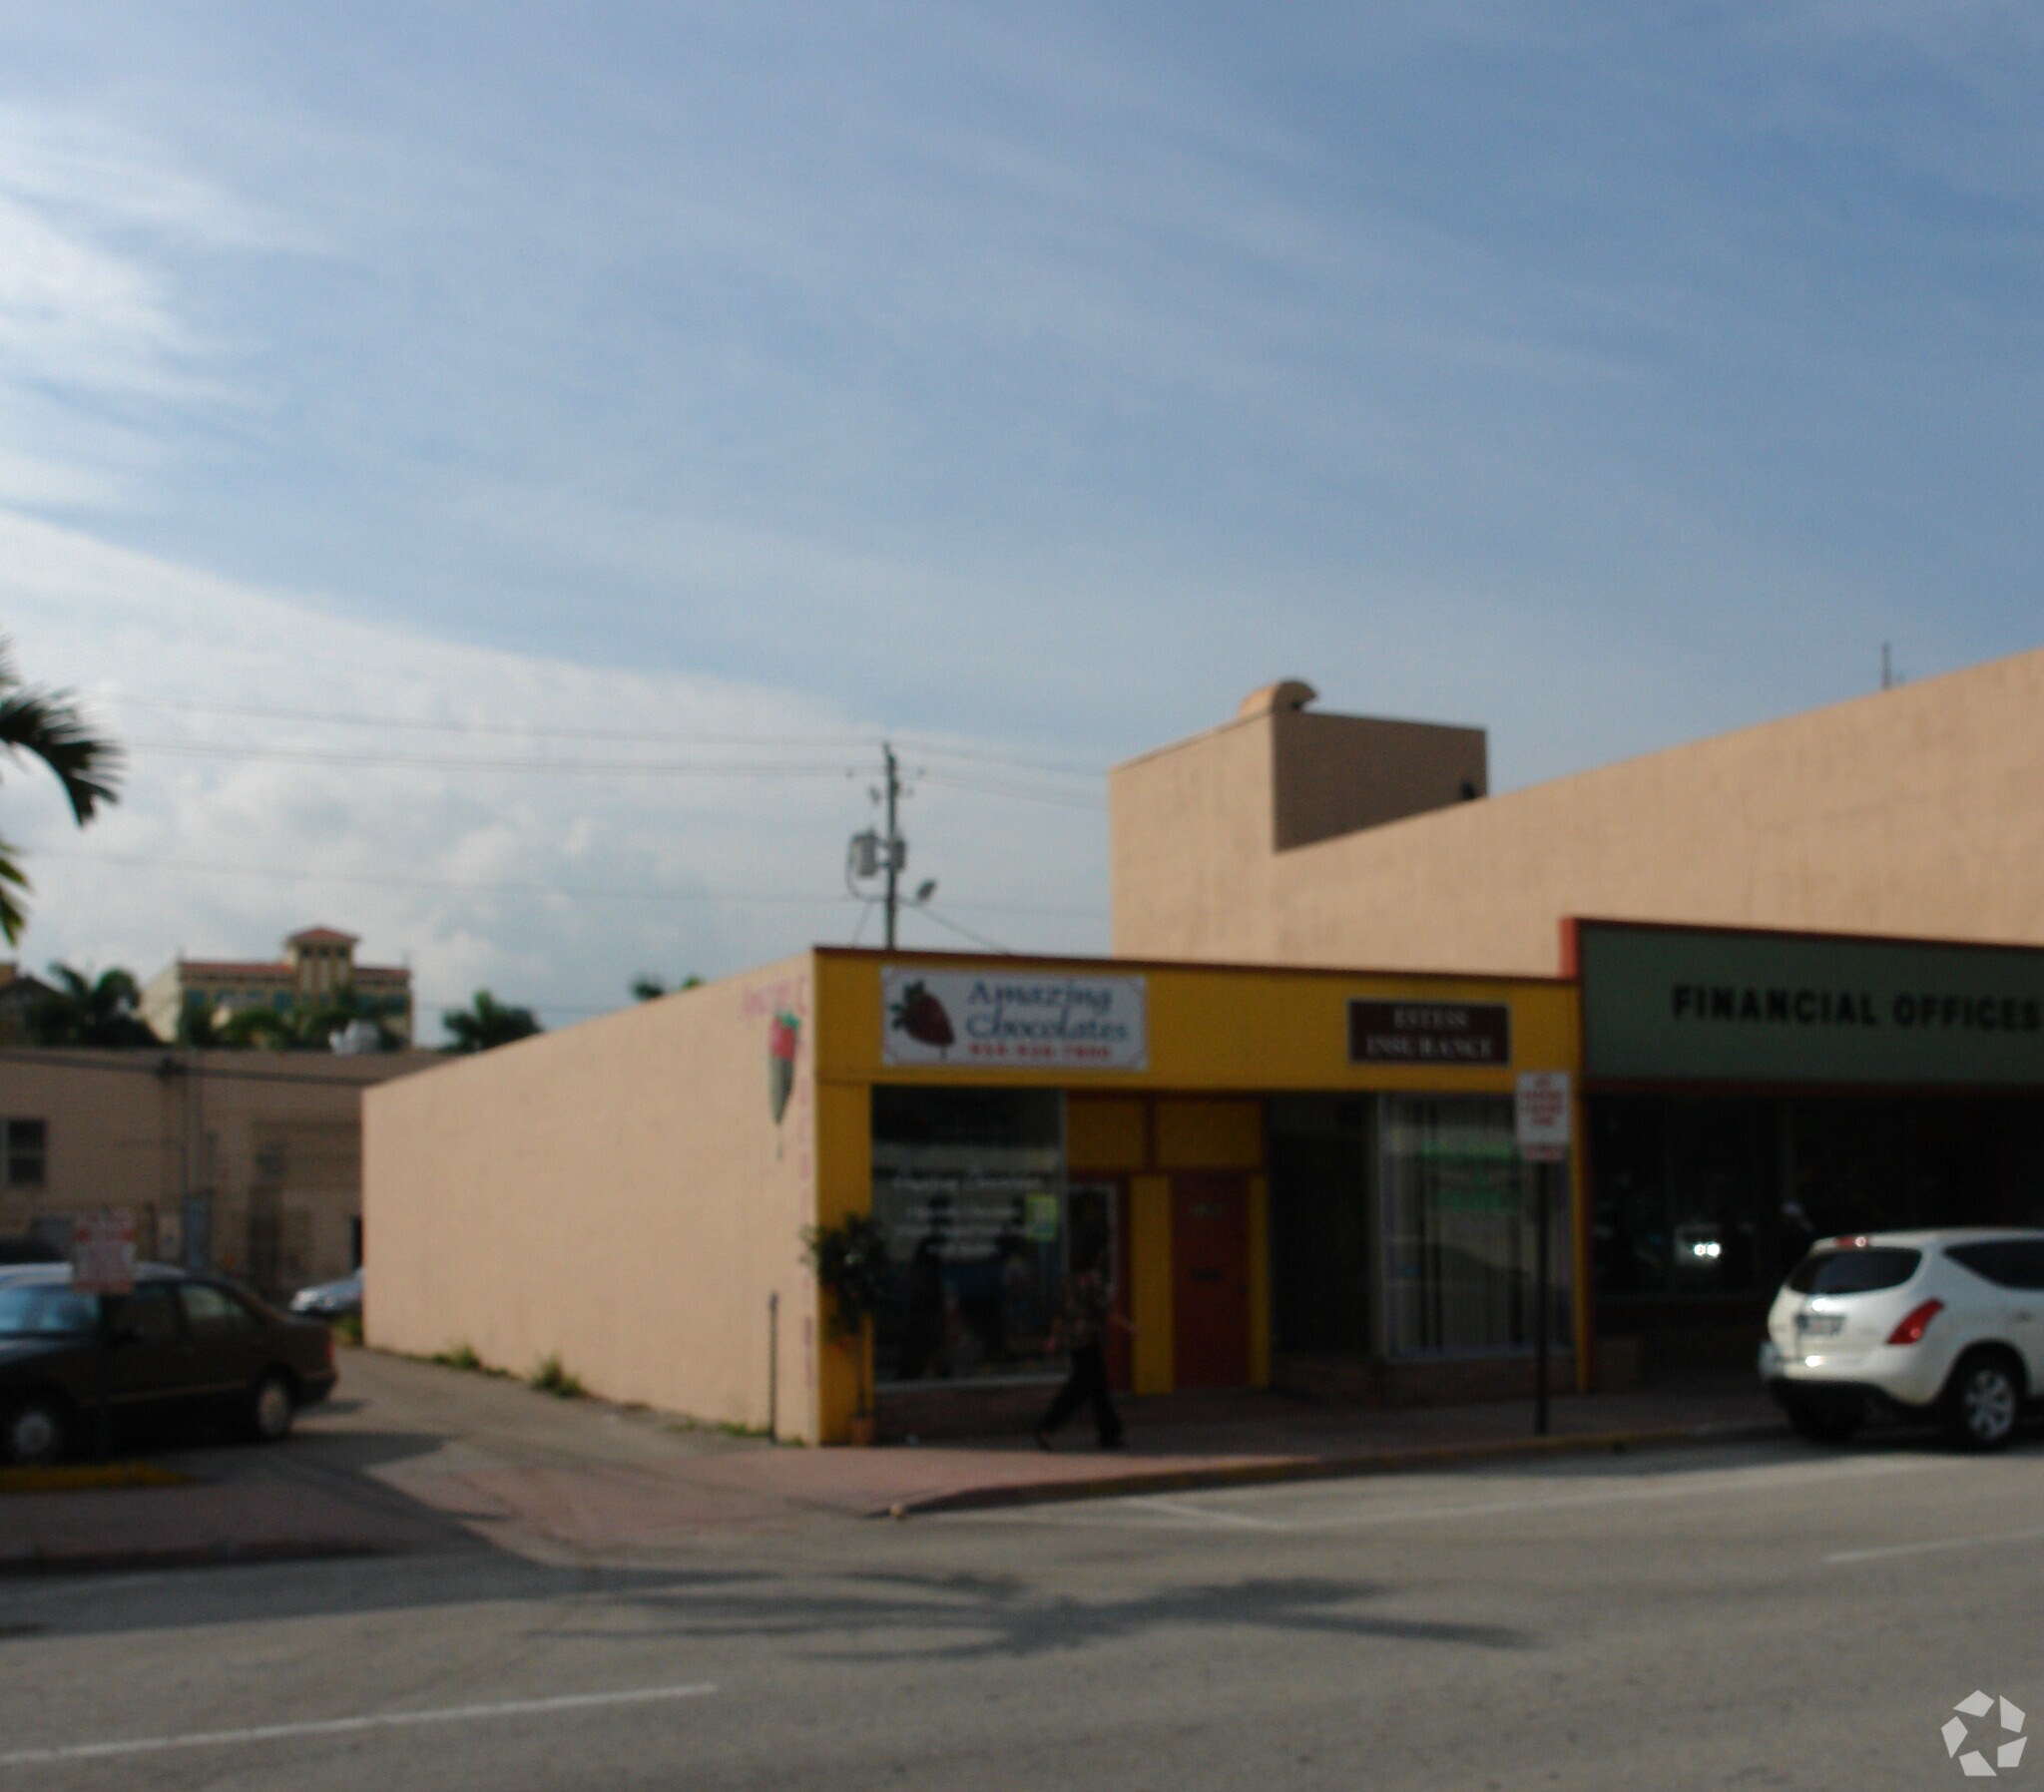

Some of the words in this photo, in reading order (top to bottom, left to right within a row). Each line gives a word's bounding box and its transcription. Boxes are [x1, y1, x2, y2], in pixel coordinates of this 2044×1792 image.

[967, 979, 1113, 1015] Amazing
[1672, 984, 1877, 1026] FINANCIAL
[1891, 994, 2040, 1031] OFFICES
[965, 1004, 1130, 1039] Chocolates
[1366, 1036, 1492, 1059] INSURANCE
